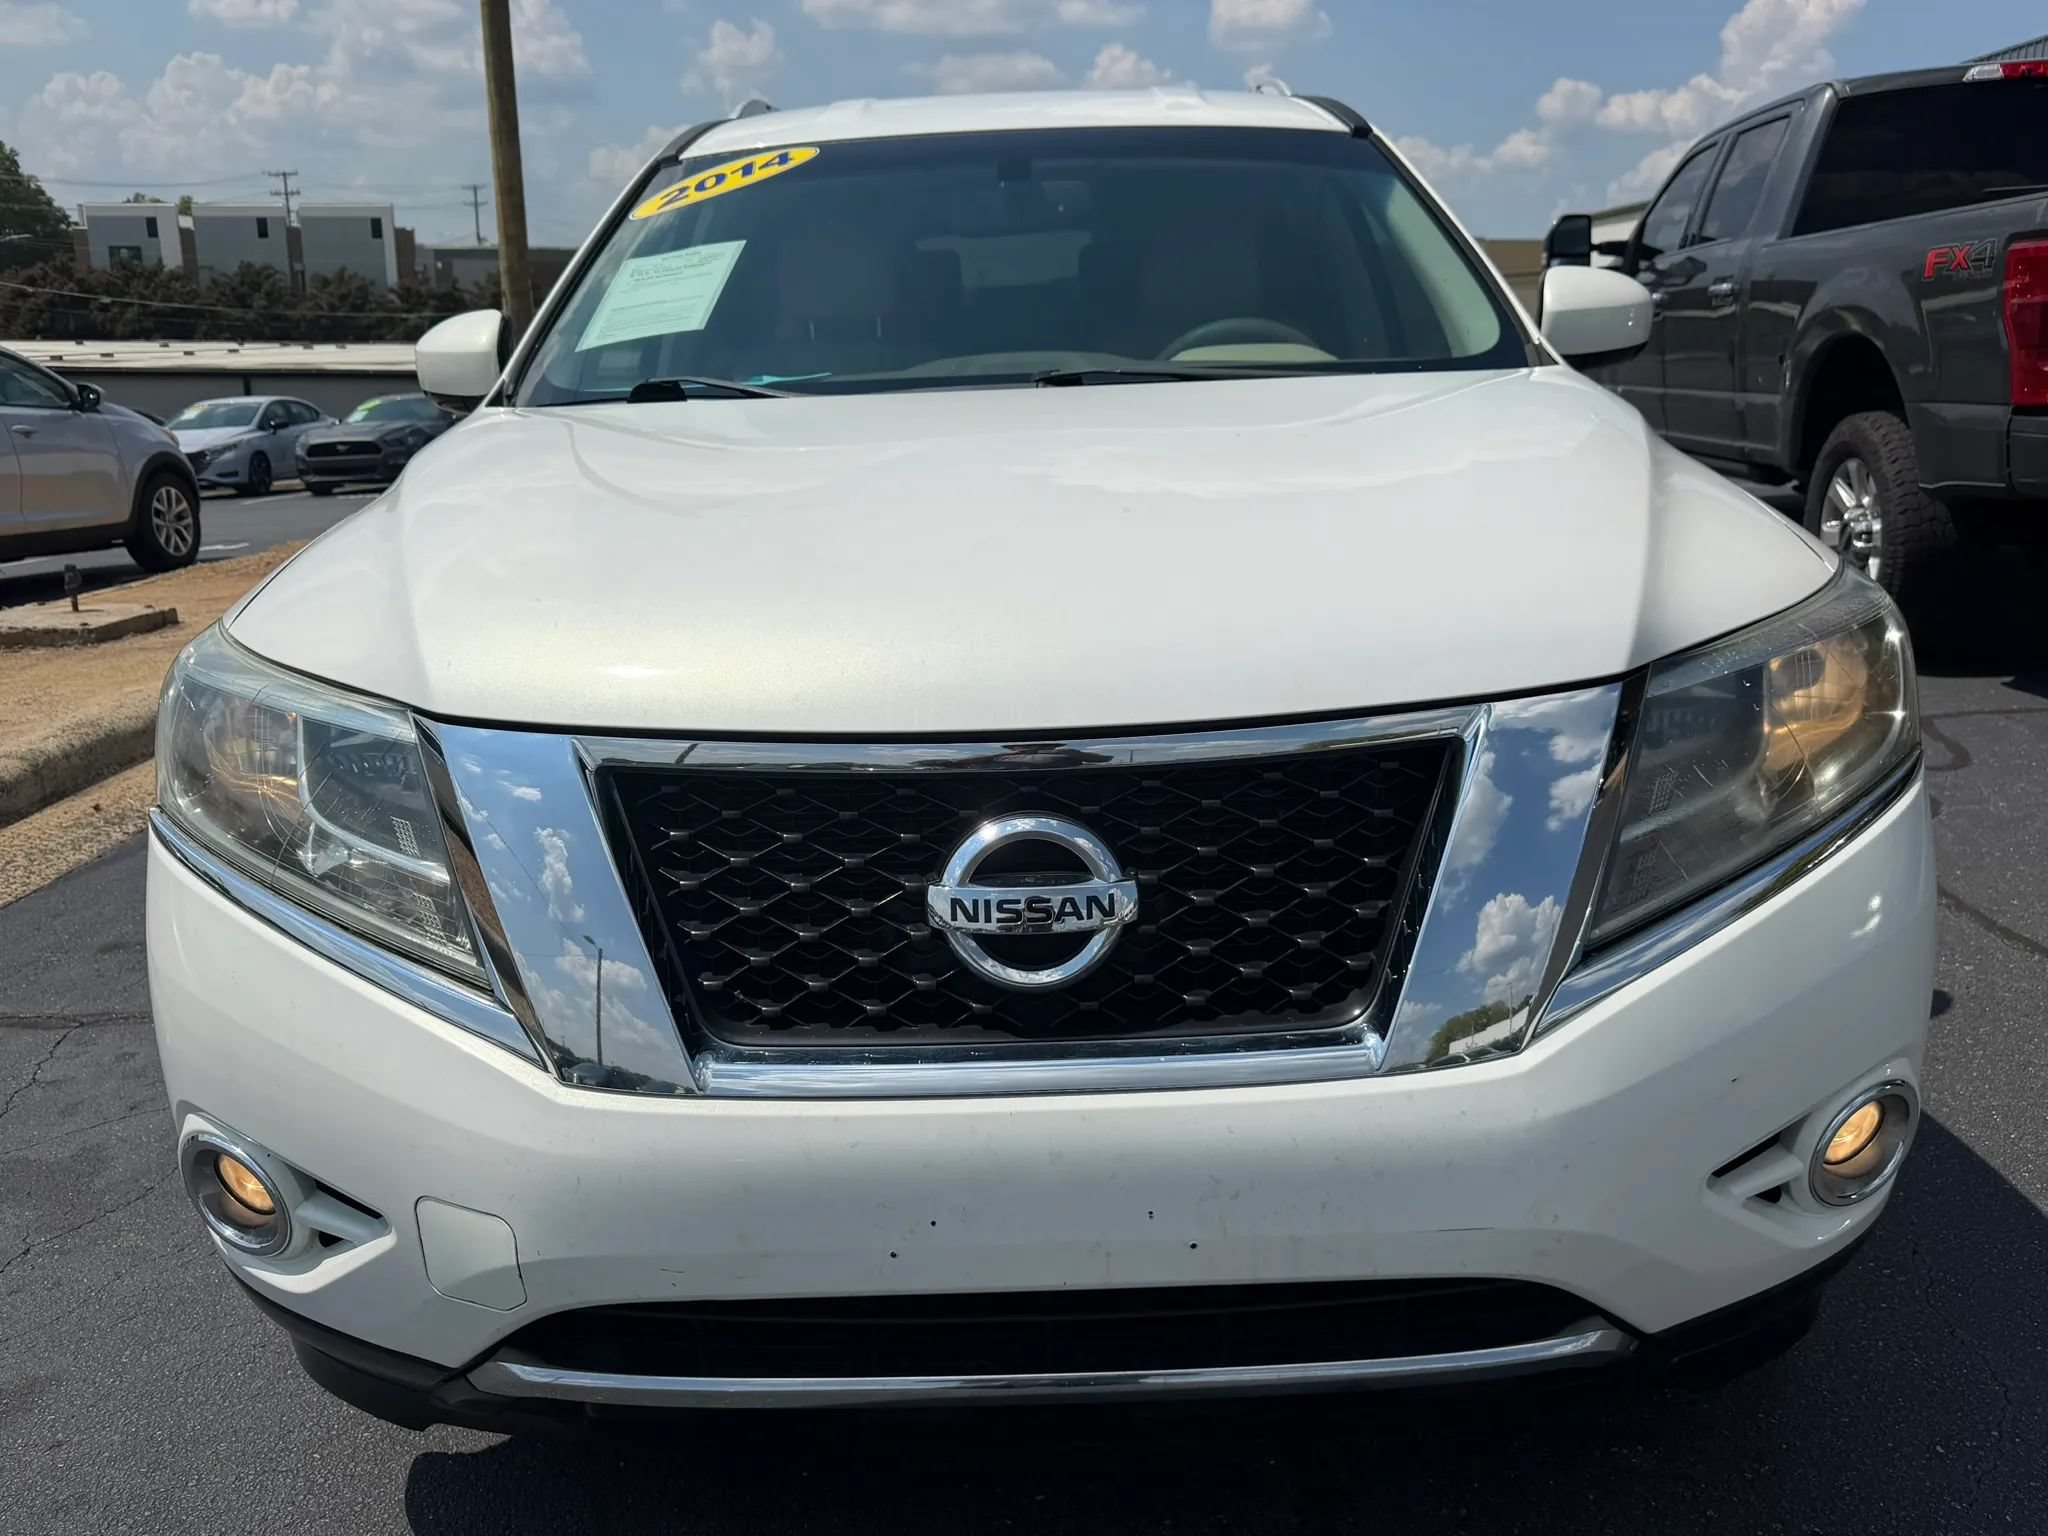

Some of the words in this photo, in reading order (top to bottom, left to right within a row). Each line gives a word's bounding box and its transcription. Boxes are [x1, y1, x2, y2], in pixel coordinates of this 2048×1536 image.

[656, 151, 795, 211] 2014
[1922, 238, 1997, 281] FX4
[950, 893, 1115, 924] NISSAN
